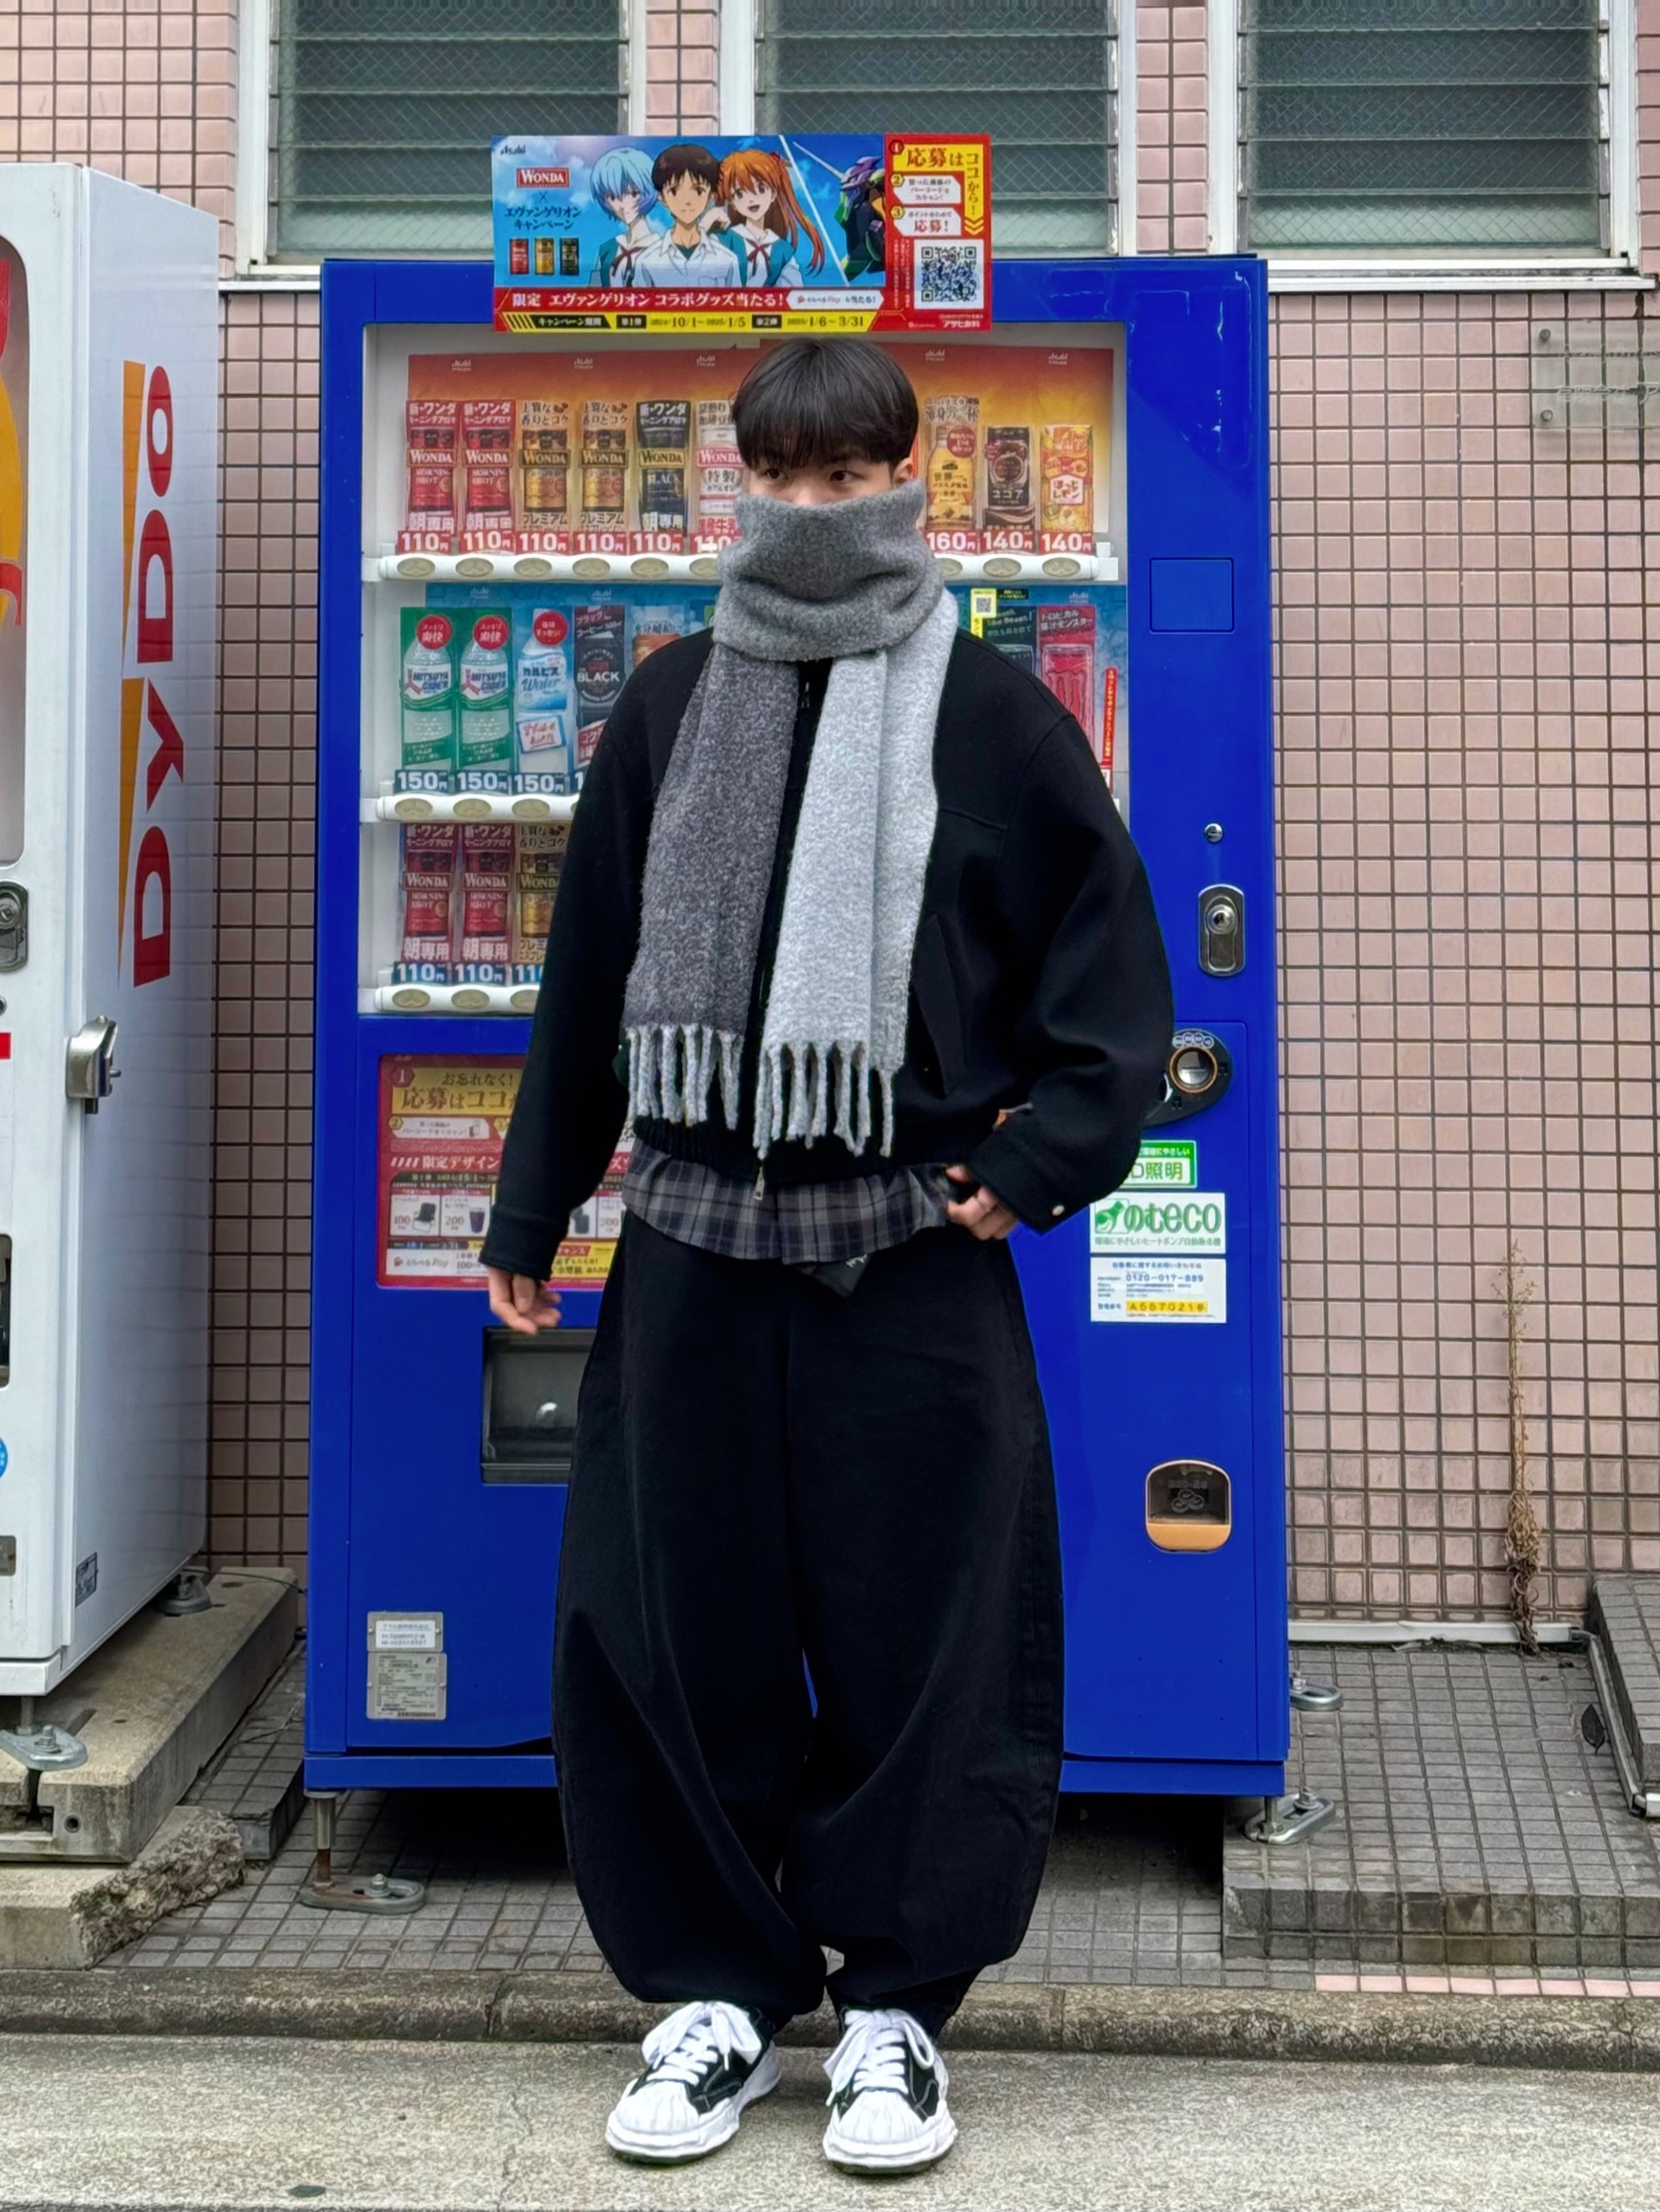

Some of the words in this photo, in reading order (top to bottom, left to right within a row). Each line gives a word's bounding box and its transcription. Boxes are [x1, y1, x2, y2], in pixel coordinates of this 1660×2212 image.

[520, 168, 565, 184] WONDA
[894, 175, 901, 185] 2
[504, 205, 583, 218] エヴァンゲリオン
[895, 208, 901, 217] 3
[514, 219, 575, 231] キャンペーン
[549, 292, 650, 308] エヴァンゲリオン
[410, 449, 453, 464] WONDA
[466, 449, 509, 464] WONDA
[524, 449, 567, 464] WONDA
[582, 449, 624, 464] WONDA
[642, 450, 683, 464] WONDA
[992, 489, 1024, 499] ココア
[523, 513, 568, 525] プレミアム
[580, 513, 625, 524] プレミアム
[401, 532, 449, 552] 110円
[463, 530, 511, 551] 110円
[520, 532, 567, 552] 110円
[577, 533, 625, 552] 110円
[633, 533, 681, 552] 110円
[927, 531, 977, 551] 160円
[982, 531, 1033, 550] 140円
[1041, 533, 1092, 552] 140円
[413, 672, 449, 682] MITSUYA
[471, 672, 507, 682] MITSUYA
[577, 671, 621, 683] BLACK
[398, 772, 447, 790] 150円
[458, 771, 507, 790] 150円
[514, 774, 564, 793] 150円
[407, 872, 449, 888] WONDA
[465, 872, 507, 888] WONDA
[403, 936, 450, 961] 朝専用
[462, 937, 509, 961] 朝専用
[397, 963, 445, 983] 110円
[454, 963, 504, 983] 110円
[399, 1068, 406, 1084] 1
[442, 1072, 513, 1086] お忘れなく!
[445, 1216, 465, 1225] 200
